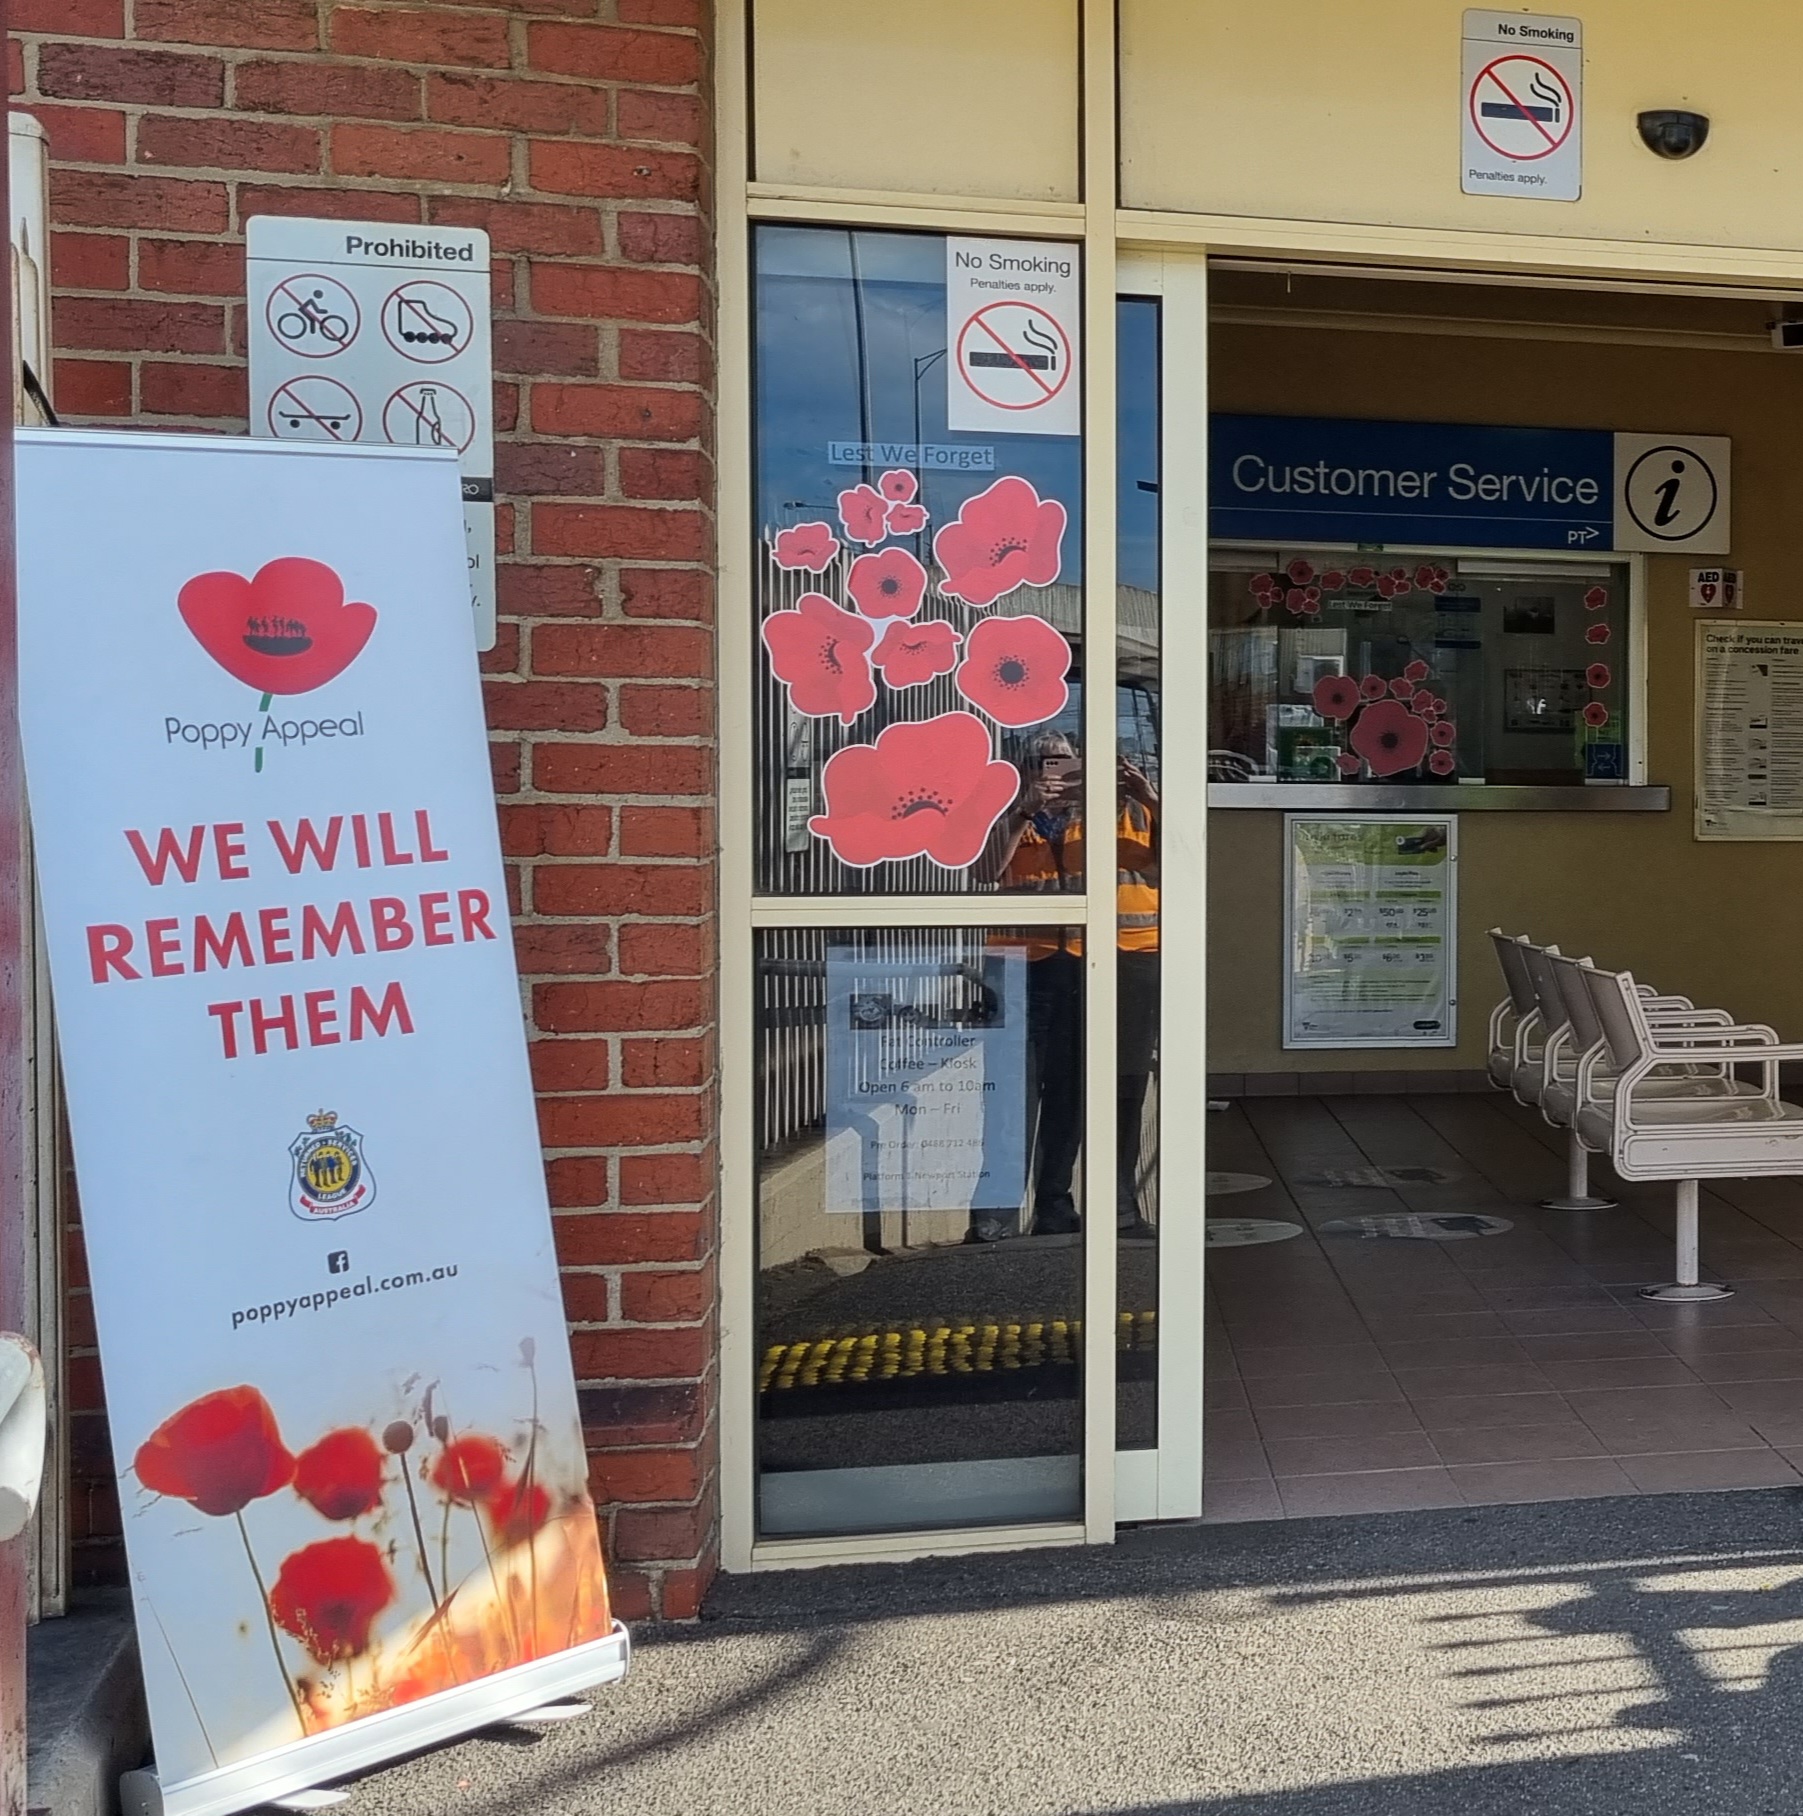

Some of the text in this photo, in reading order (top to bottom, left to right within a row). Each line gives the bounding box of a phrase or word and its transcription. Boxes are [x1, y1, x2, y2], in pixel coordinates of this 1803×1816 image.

[1498, 23, 1575, 43] No Smoking
[1469, 168, 1548, 186] Penalties apply.
[346, 234, 474, 263] Prohibited
[955, 251, 1071, 278] No Smoking
[970, 277, 1057, 294] Penalties apply.
[832, 443, 993, 469] Lest We Forget
[1232, 454, 1599, 505] Customer Service
[1697, 571, 1720, 583] AED
[1728, 645, 1779, 655] concession
[1780, 646, 1800, 655] fare
[1746, 636, 1763, 646] you
[1764, 637, 1781, 645] can
[165, 710, 364, 750] Poppy Appeal
[123, 809, 449, 887] WE WILL
[85, 889, 497, 985] REMEMBER
[208, 981, 415, 1060] THEM
[940, 1056, 977, 1070] Kiosk
[859, 1081, 897, 1096] Open
[913, 1083, 935, 1092] am
[939, 1081, 954, 1092] to
[958, 1080, 997, 1093] 10am
[895, 1103, 927, 1116] Mon
[943, 1102, 961, 1115] Fri
[231, 1263, 459, 1330] poppyappeal.com.au
